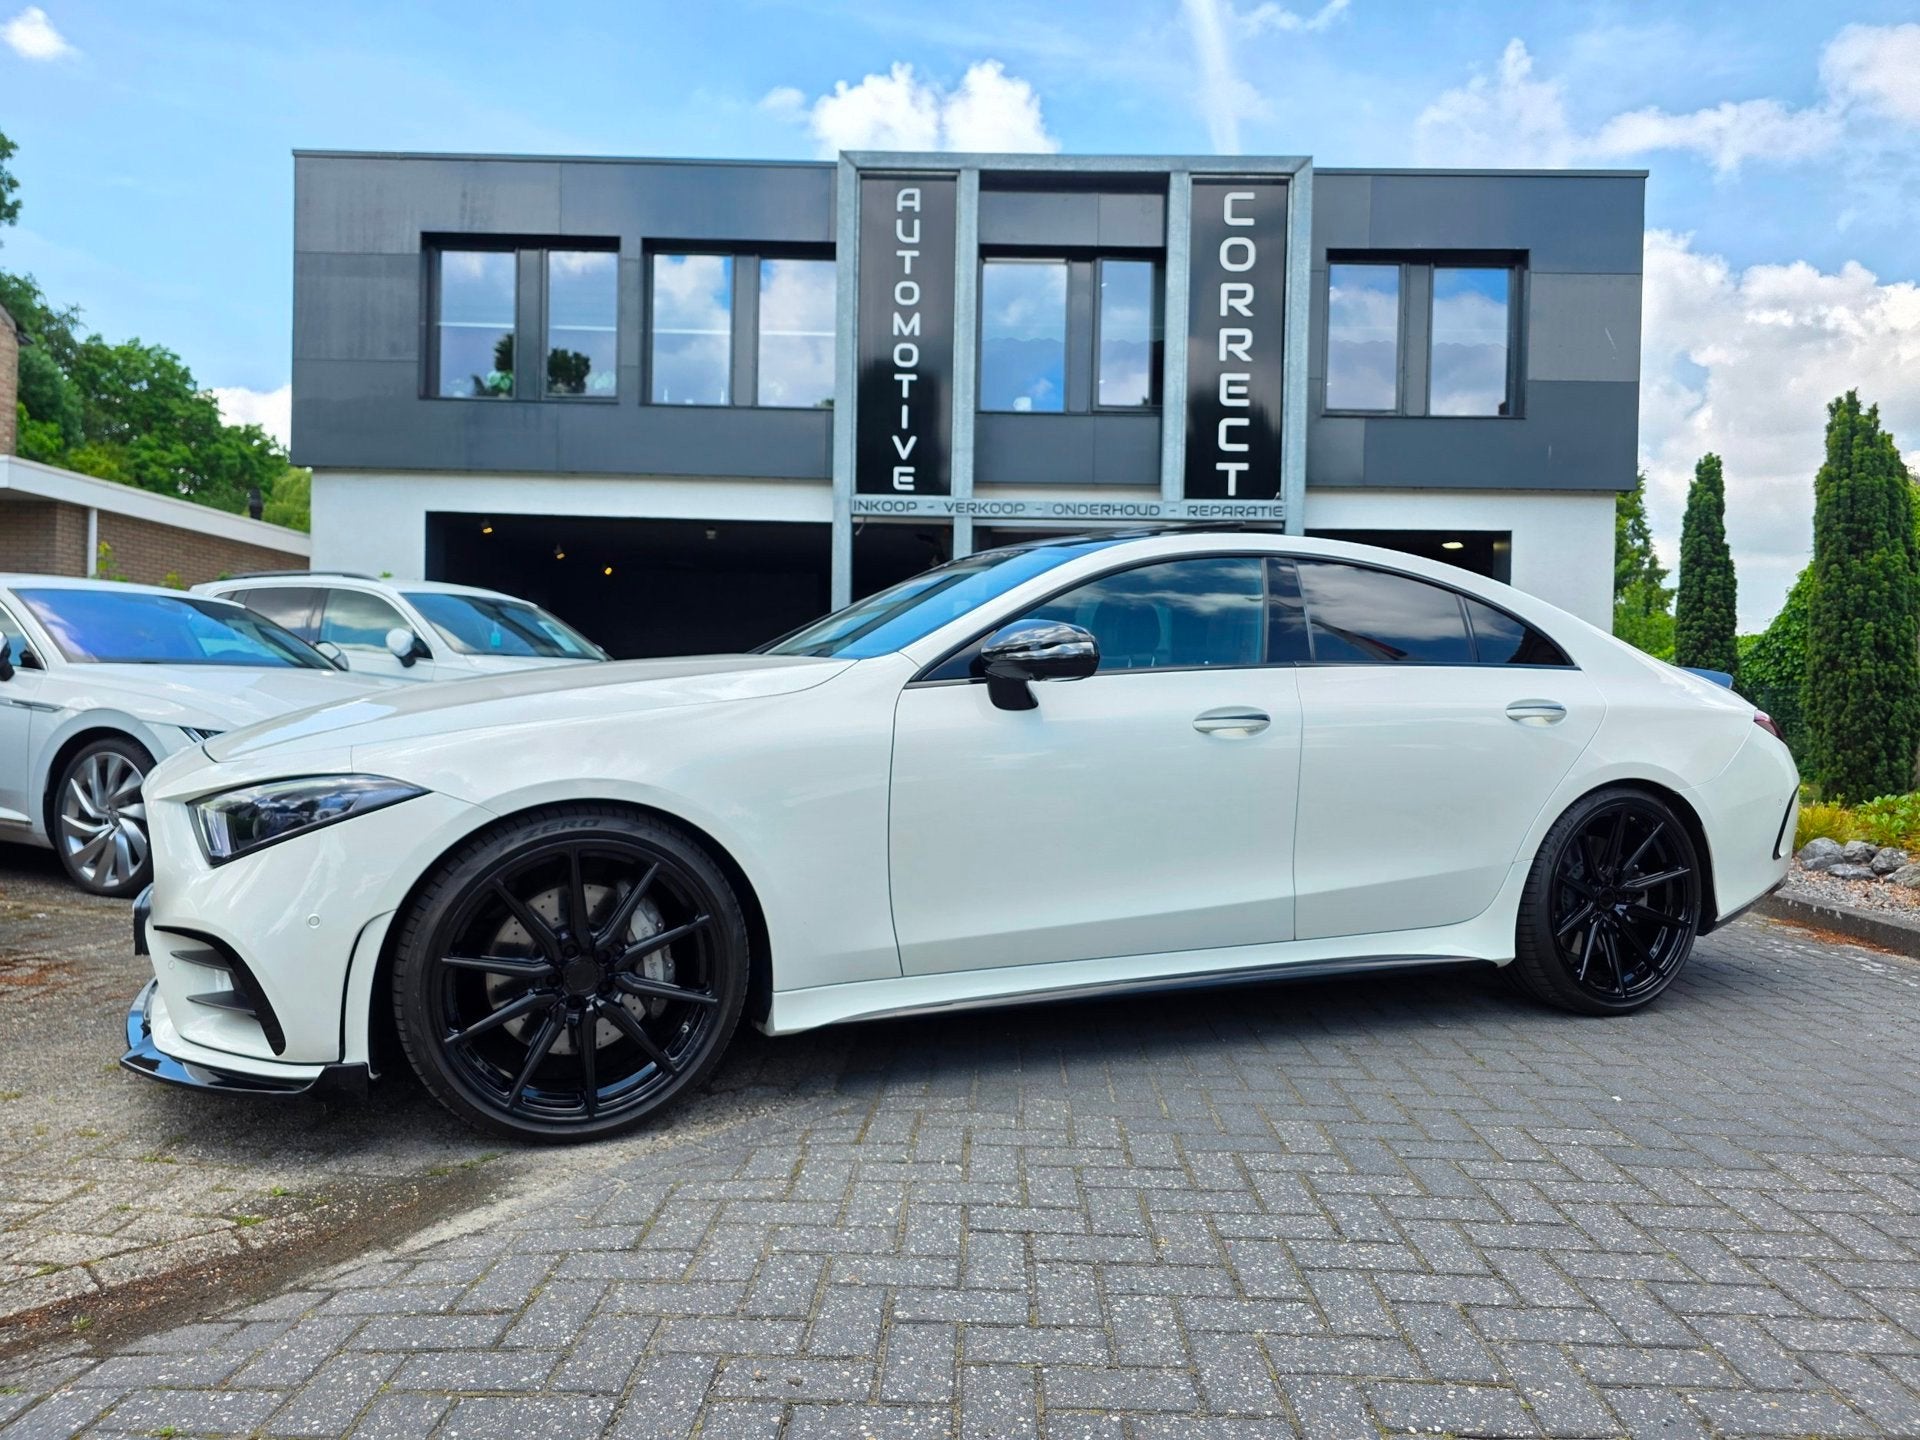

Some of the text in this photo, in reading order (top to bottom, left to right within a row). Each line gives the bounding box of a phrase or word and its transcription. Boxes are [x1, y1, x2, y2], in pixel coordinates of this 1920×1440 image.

[892, 187, 921, 491] AUTOMOTIVE
[1216, 191, 1257, 496] CORRECT
[853, 500, 918, 512] INKOOP
[944, 502, 1026, 514] VERKOOP
[1052, 503, 1160, 516] ONDERHOUD
[1187, 505, 1284, 517] REPARATIE
[523, 819, 601, 840] ZERO
